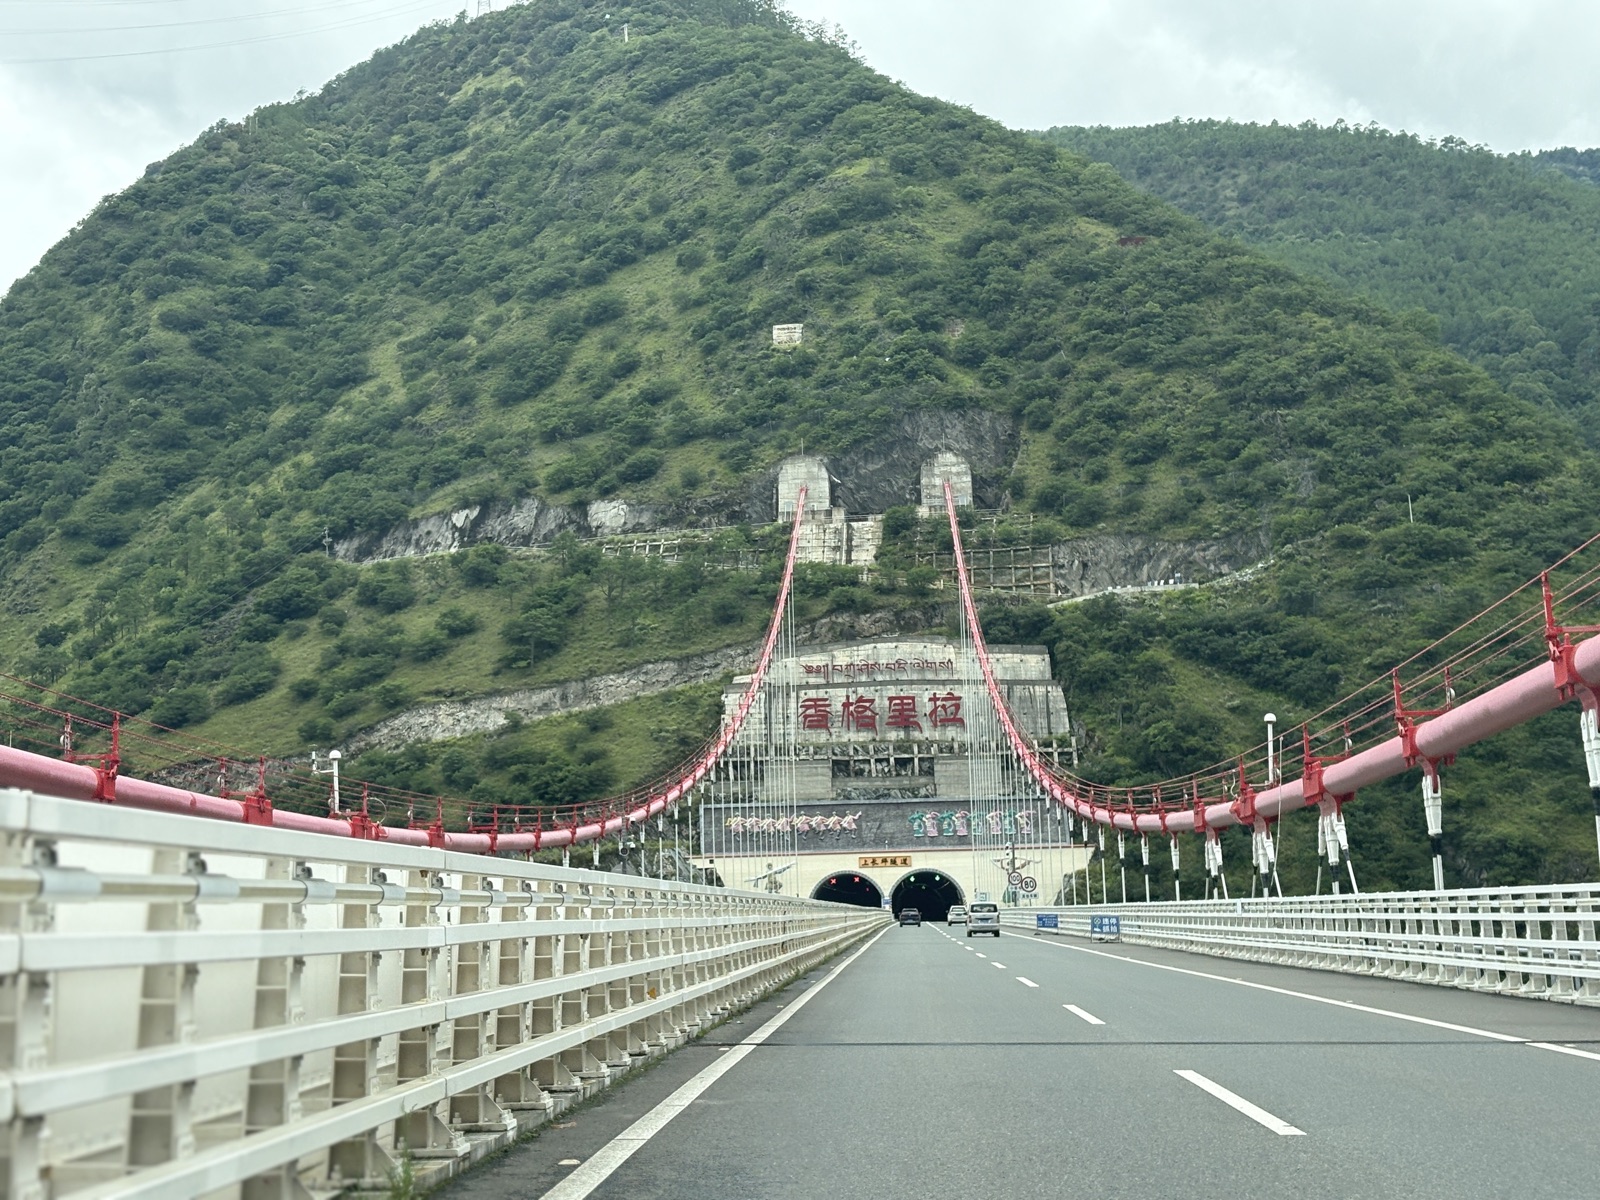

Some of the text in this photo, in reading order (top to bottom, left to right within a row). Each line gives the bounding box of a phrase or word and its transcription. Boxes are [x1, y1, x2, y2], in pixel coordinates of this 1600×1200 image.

[798, 692, 966, 735] 香格里拉
[1024, 880, 1034, 889] 80
